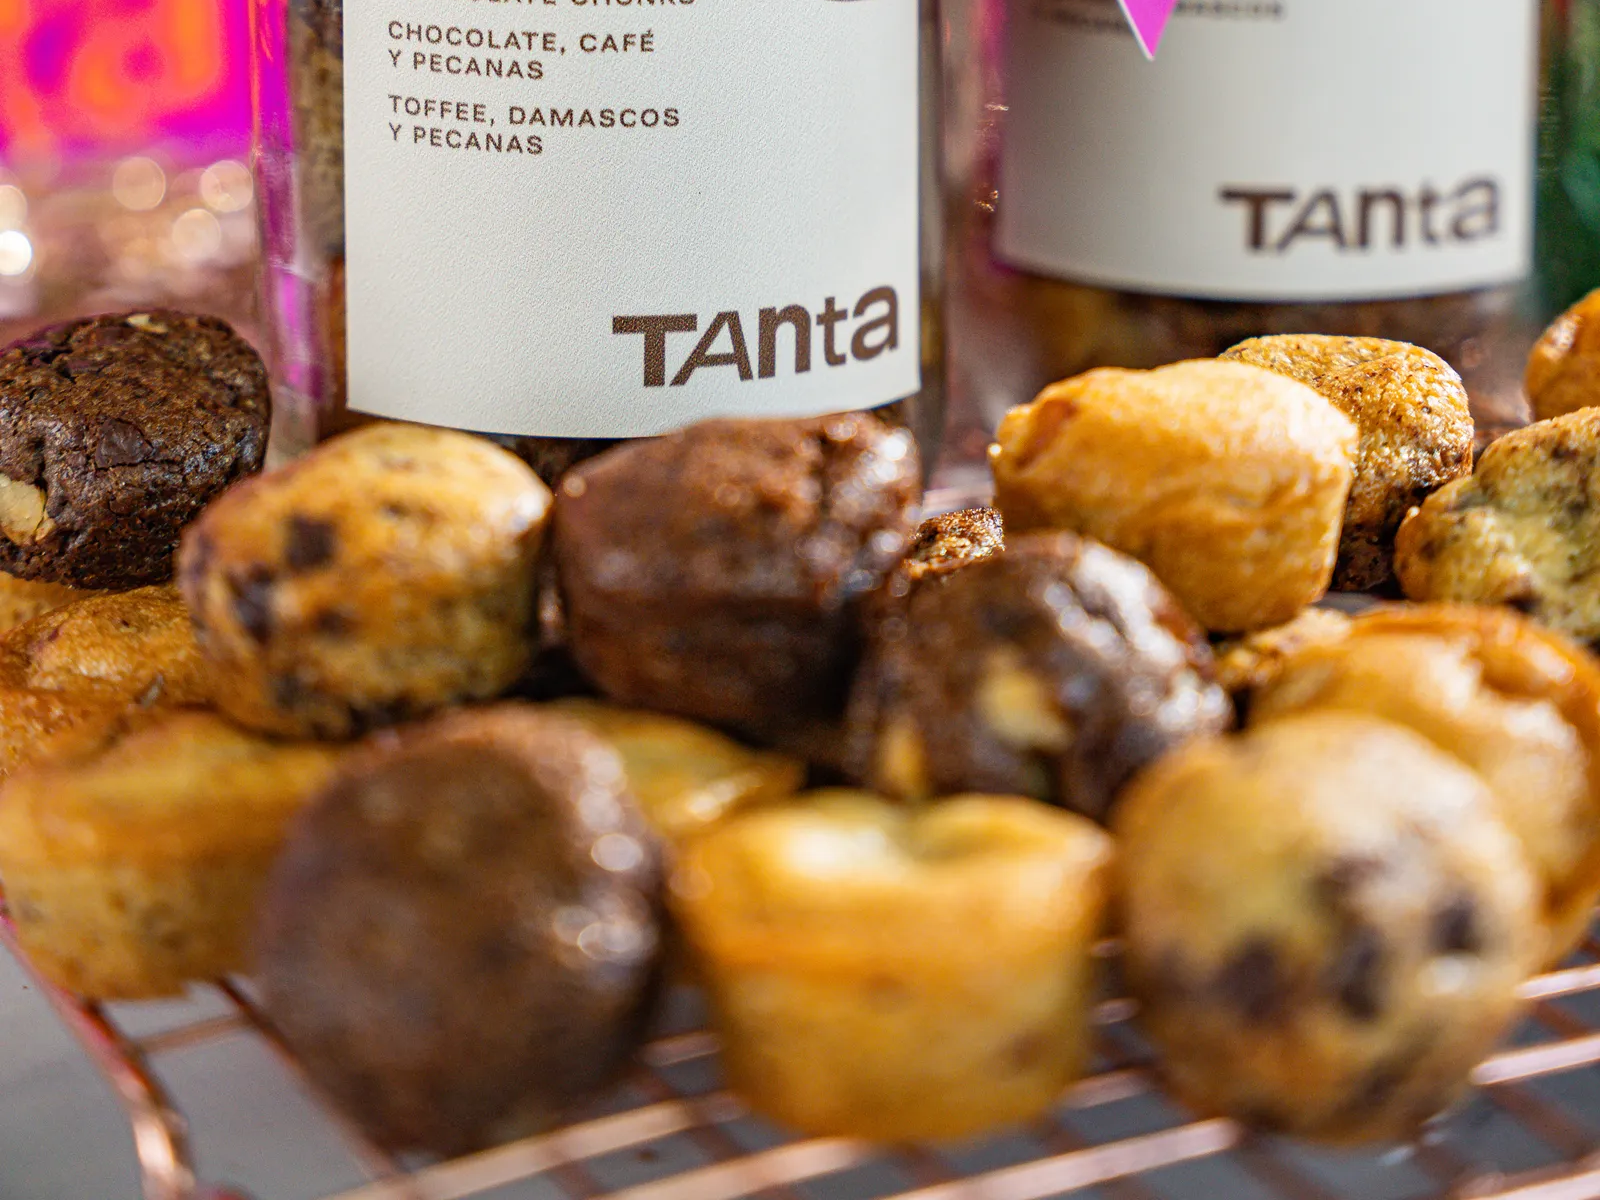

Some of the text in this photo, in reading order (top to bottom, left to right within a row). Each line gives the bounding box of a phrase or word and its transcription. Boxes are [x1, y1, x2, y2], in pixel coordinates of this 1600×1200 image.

[388, 20, 655, 55] CHOCOLATE, CAFÉ
[388, 49, 544, 80] Y PECANAS
[388, 94, 680, 128] TOFFEE, DAMASCOS
[388, 122, 544, 155] Y PECANAS
[1218, 176, 1500, 251] TAnta
[612, 286, 898, 388] TAnta
